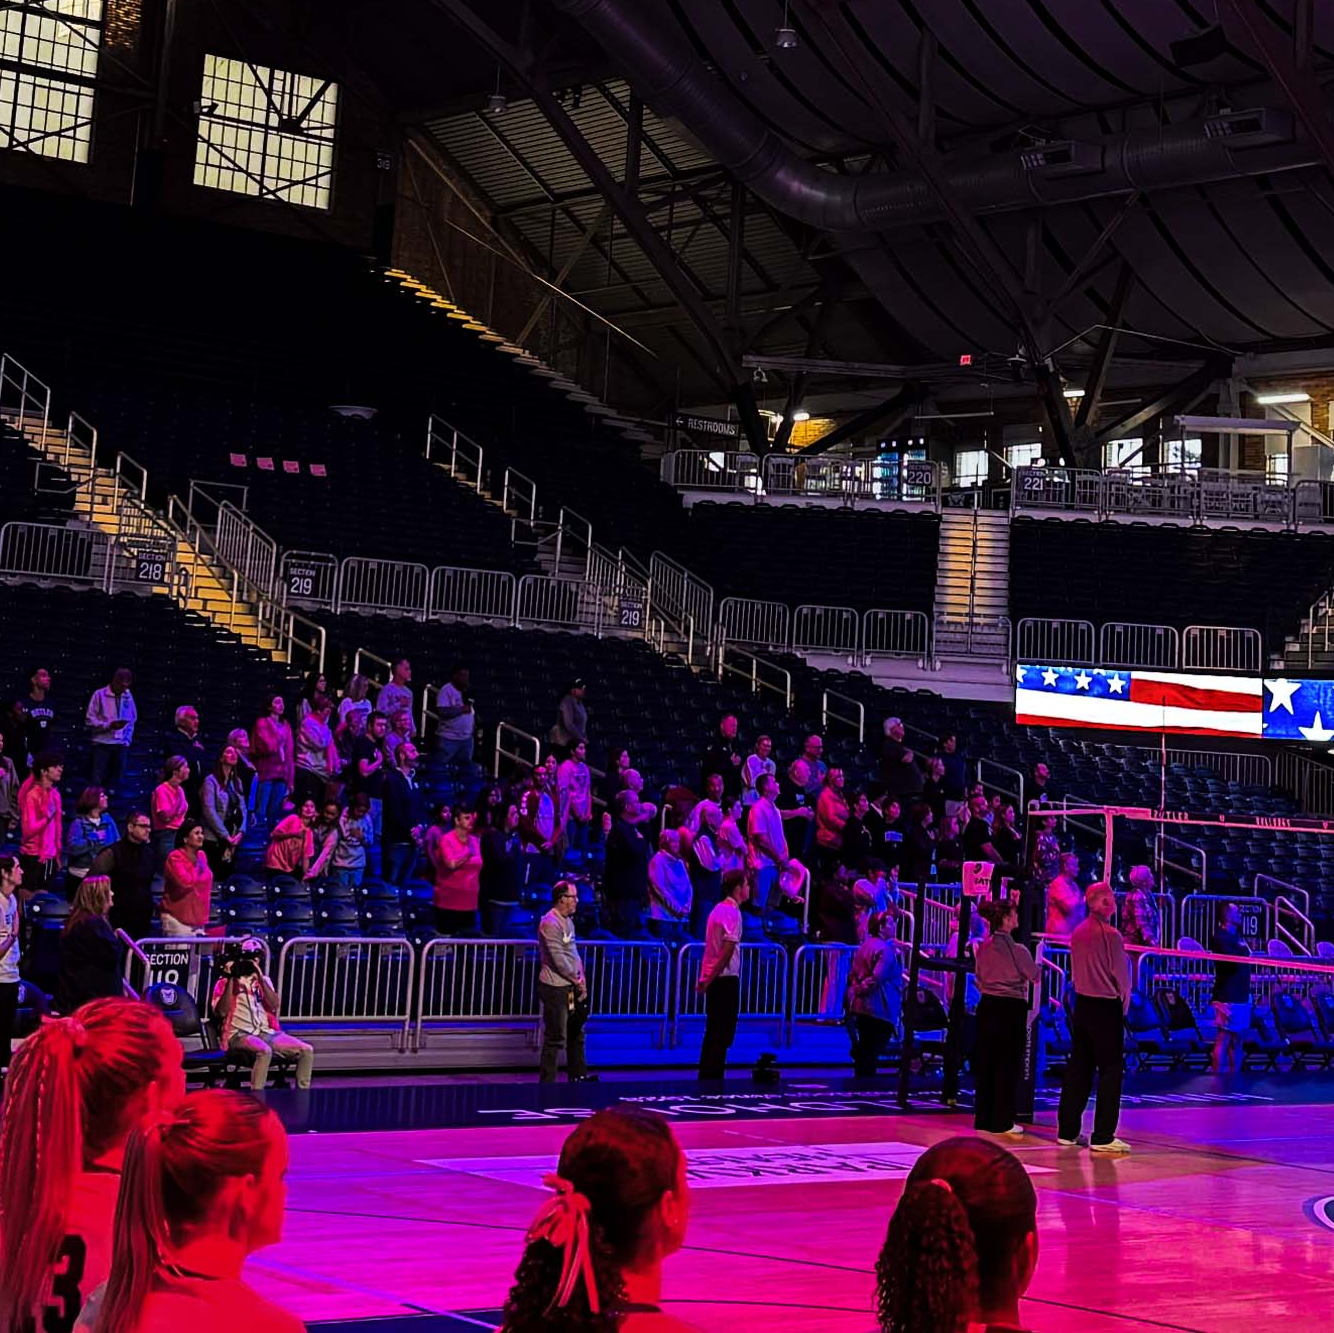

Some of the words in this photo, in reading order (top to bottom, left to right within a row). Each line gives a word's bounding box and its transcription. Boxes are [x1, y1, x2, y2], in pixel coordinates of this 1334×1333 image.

[687, 418, 736, 435] RESTROOMS
[907, 471, 932, 485] 220
[1023, 477, 1044, 490] 221
[138, 563, 163, 581] 218
[290, 577, 314, 595] 219
[621, 609, 640, 626] 219
[1242, 915, 1258, 936] 119
[147, 953, 189, 965] ECTION
